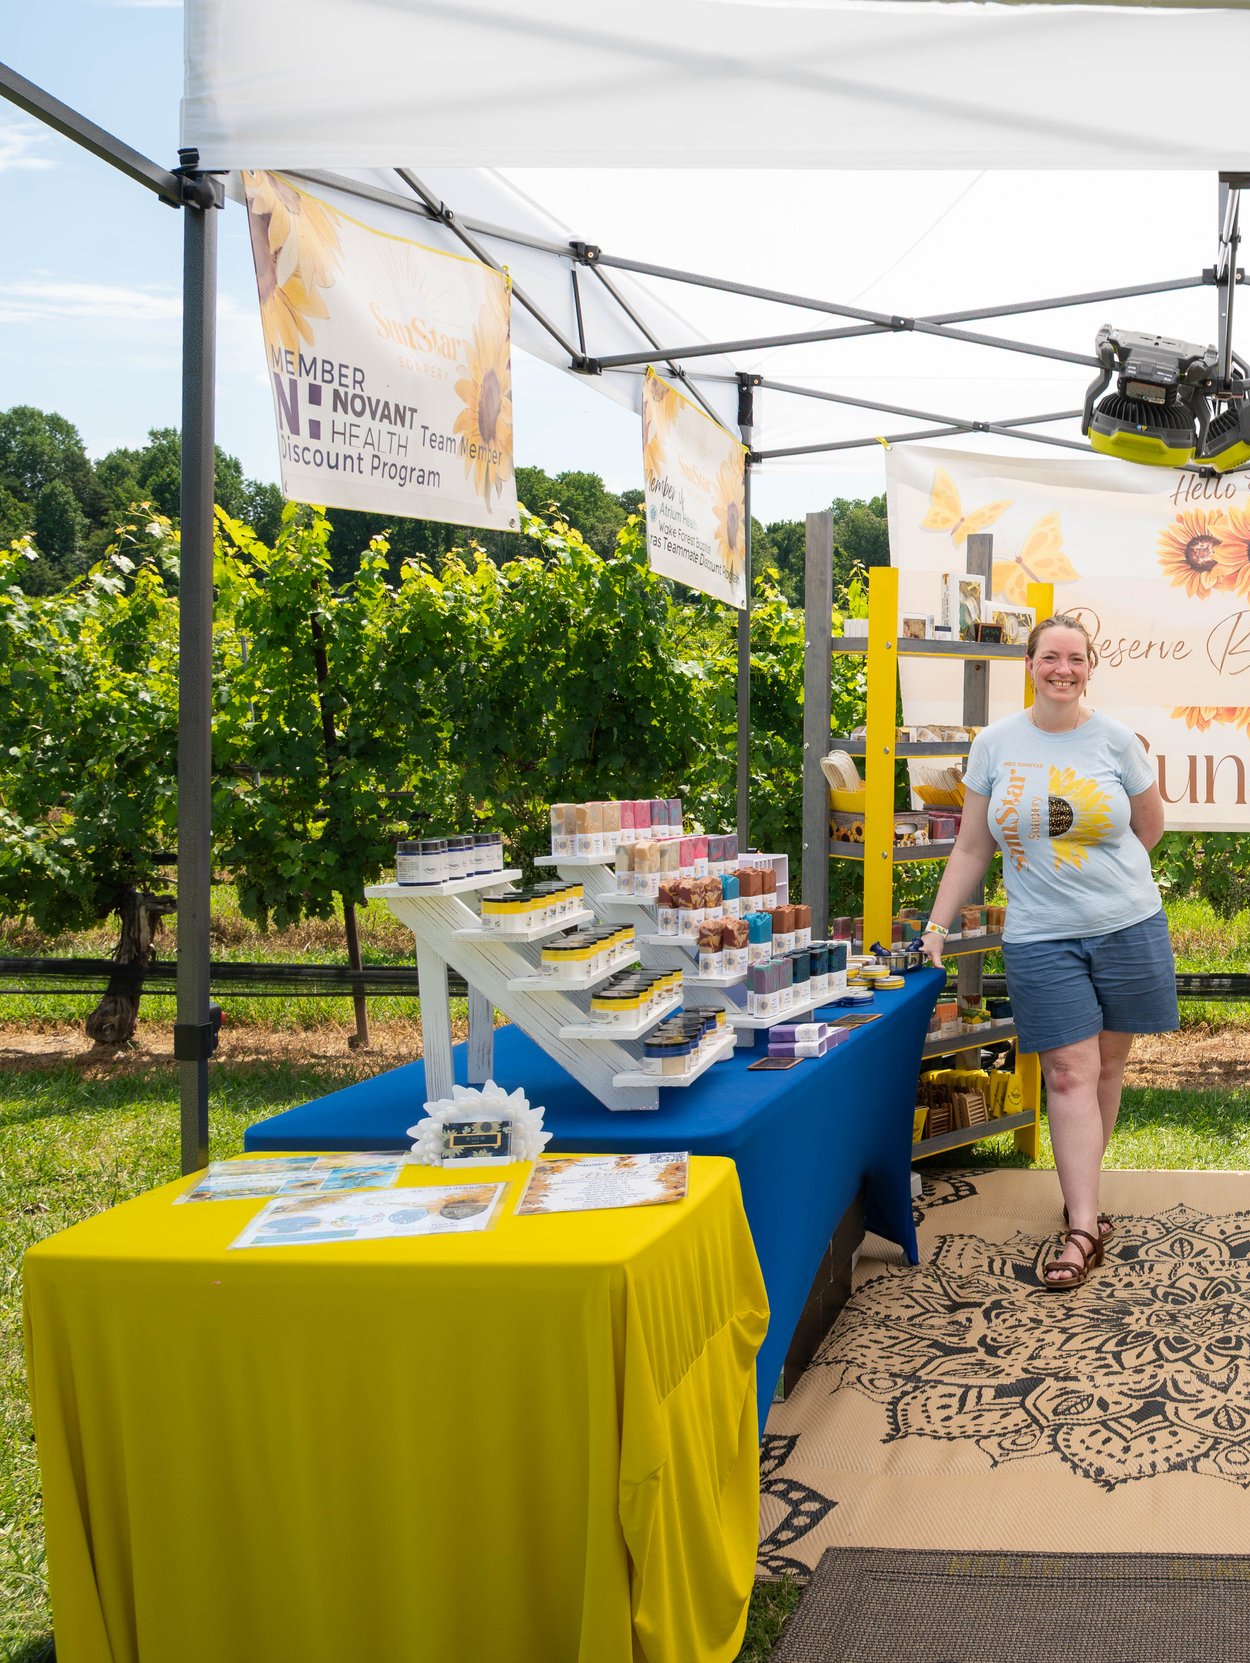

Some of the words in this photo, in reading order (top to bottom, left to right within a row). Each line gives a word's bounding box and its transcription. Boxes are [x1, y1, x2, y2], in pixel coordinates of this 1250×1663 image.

[271, 344, 365, 392] MEMBER
[332, 388, 418, 431] NOVANT
[331, 419, 409, 458] HEALTH
[420, 424, 457, 455] Team
[459, 440, 502, 466] Member
[370, 454, 441, 489] Program
[1170, 474, 1237, 506] Hello
[660, 502, 682, 521] Atrium
[650, 534, 662, 548] ras
[663, 537, 699, 563] Teammate
[699, 554, 722, 576] Discount
[677, 528, 696, 545] Forest
[995, 768, 1030, 872] SunStar
[1028, 796, 1042, 841] Soapery
